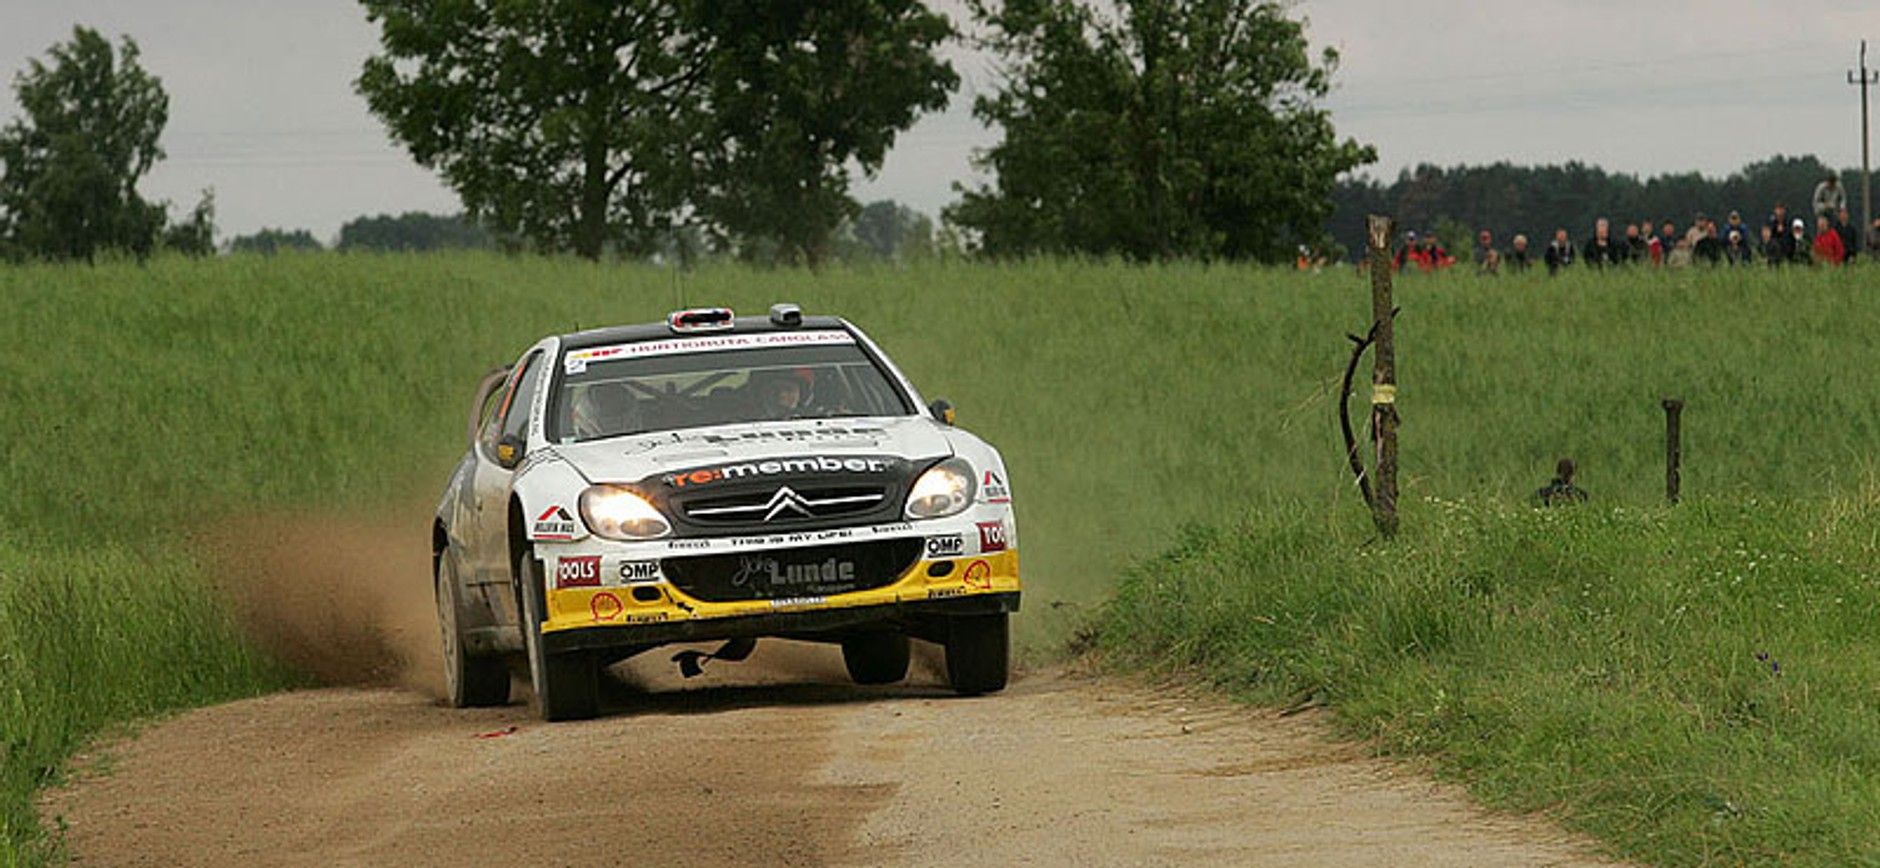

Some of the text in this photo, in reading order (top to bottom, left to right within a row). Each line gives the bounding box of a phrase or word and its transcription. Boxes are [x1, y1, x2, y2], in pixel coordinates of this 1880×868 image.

[928, 537, 964, 554] OMP
[620, 563, 659, 580] OMP
[770, 557, 855, 585] Lunde
